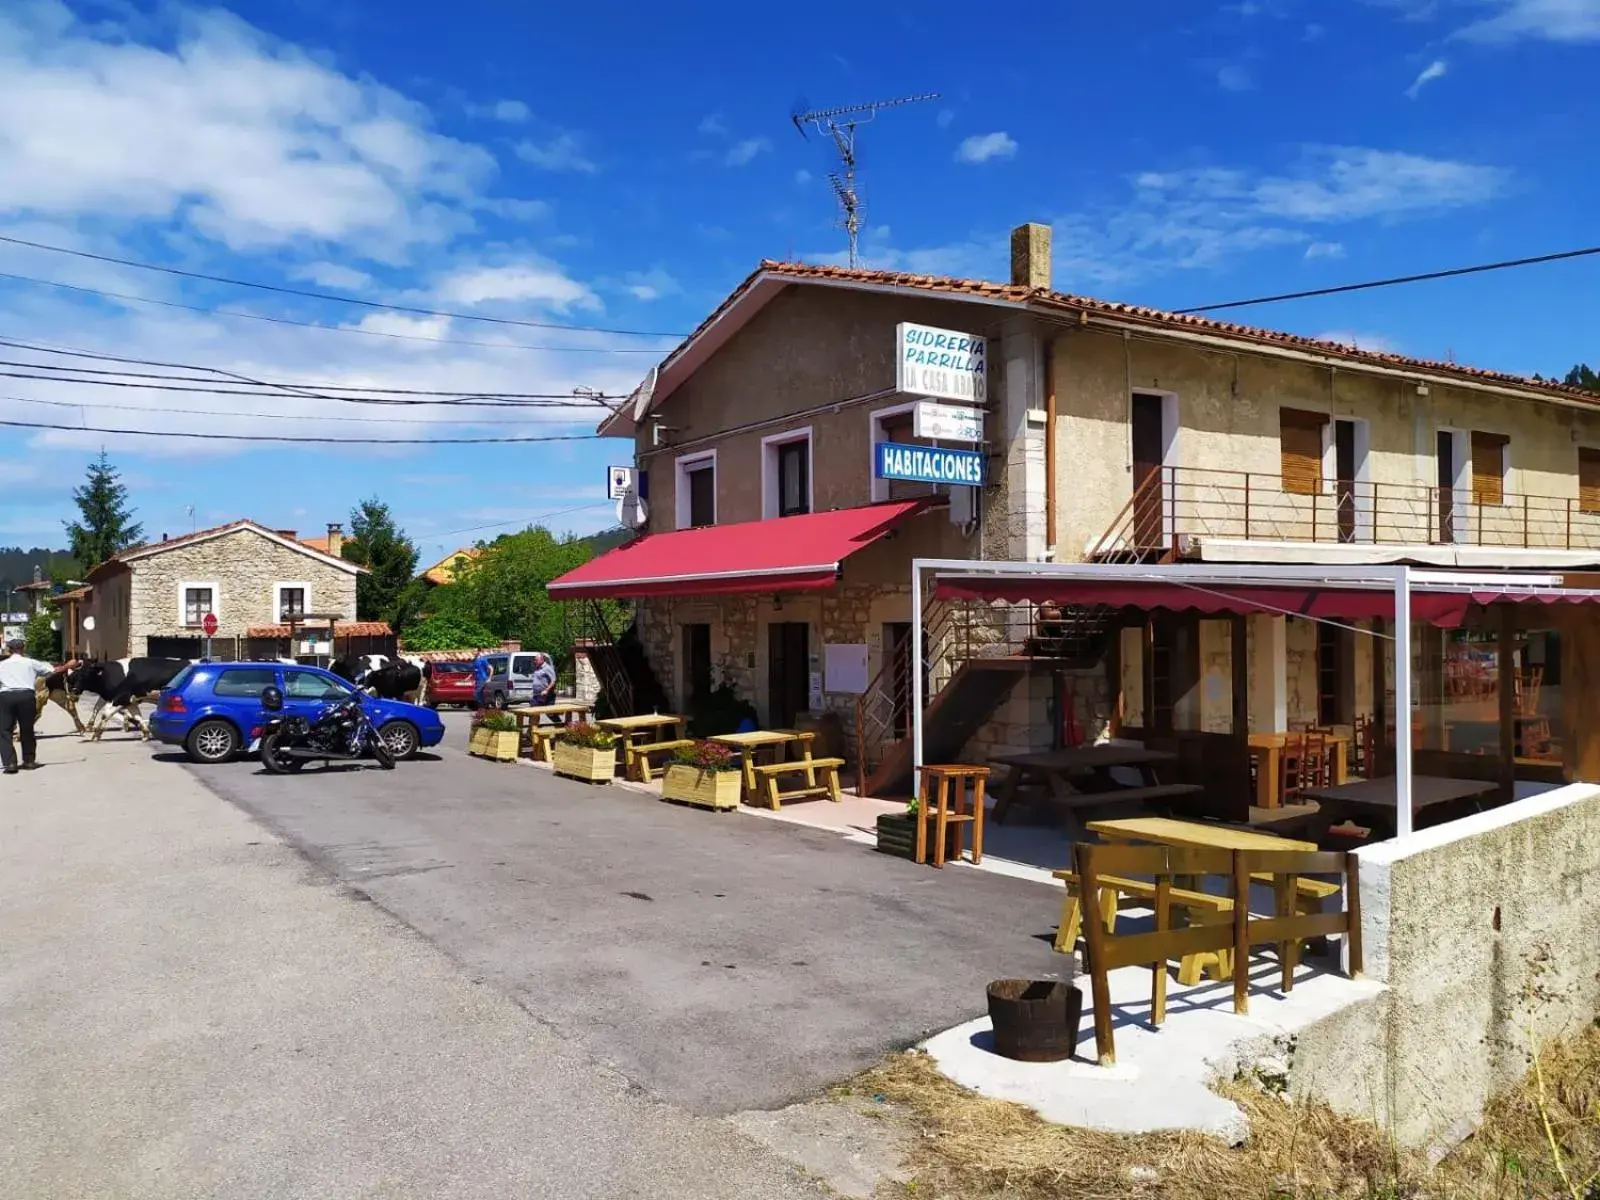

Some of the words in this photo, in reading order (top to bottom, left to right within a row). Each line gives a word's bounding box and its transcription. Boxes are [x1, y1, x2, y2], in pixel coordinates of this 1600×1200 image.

[906, 329, 984, 356] SIDRERIA
[905, 347, 984, 374] PARRILLA
[905, 366, 917, 389] LA
[922, 369, 948, 393] CASA
[884, 447, 982, 482] HABITACIONES
